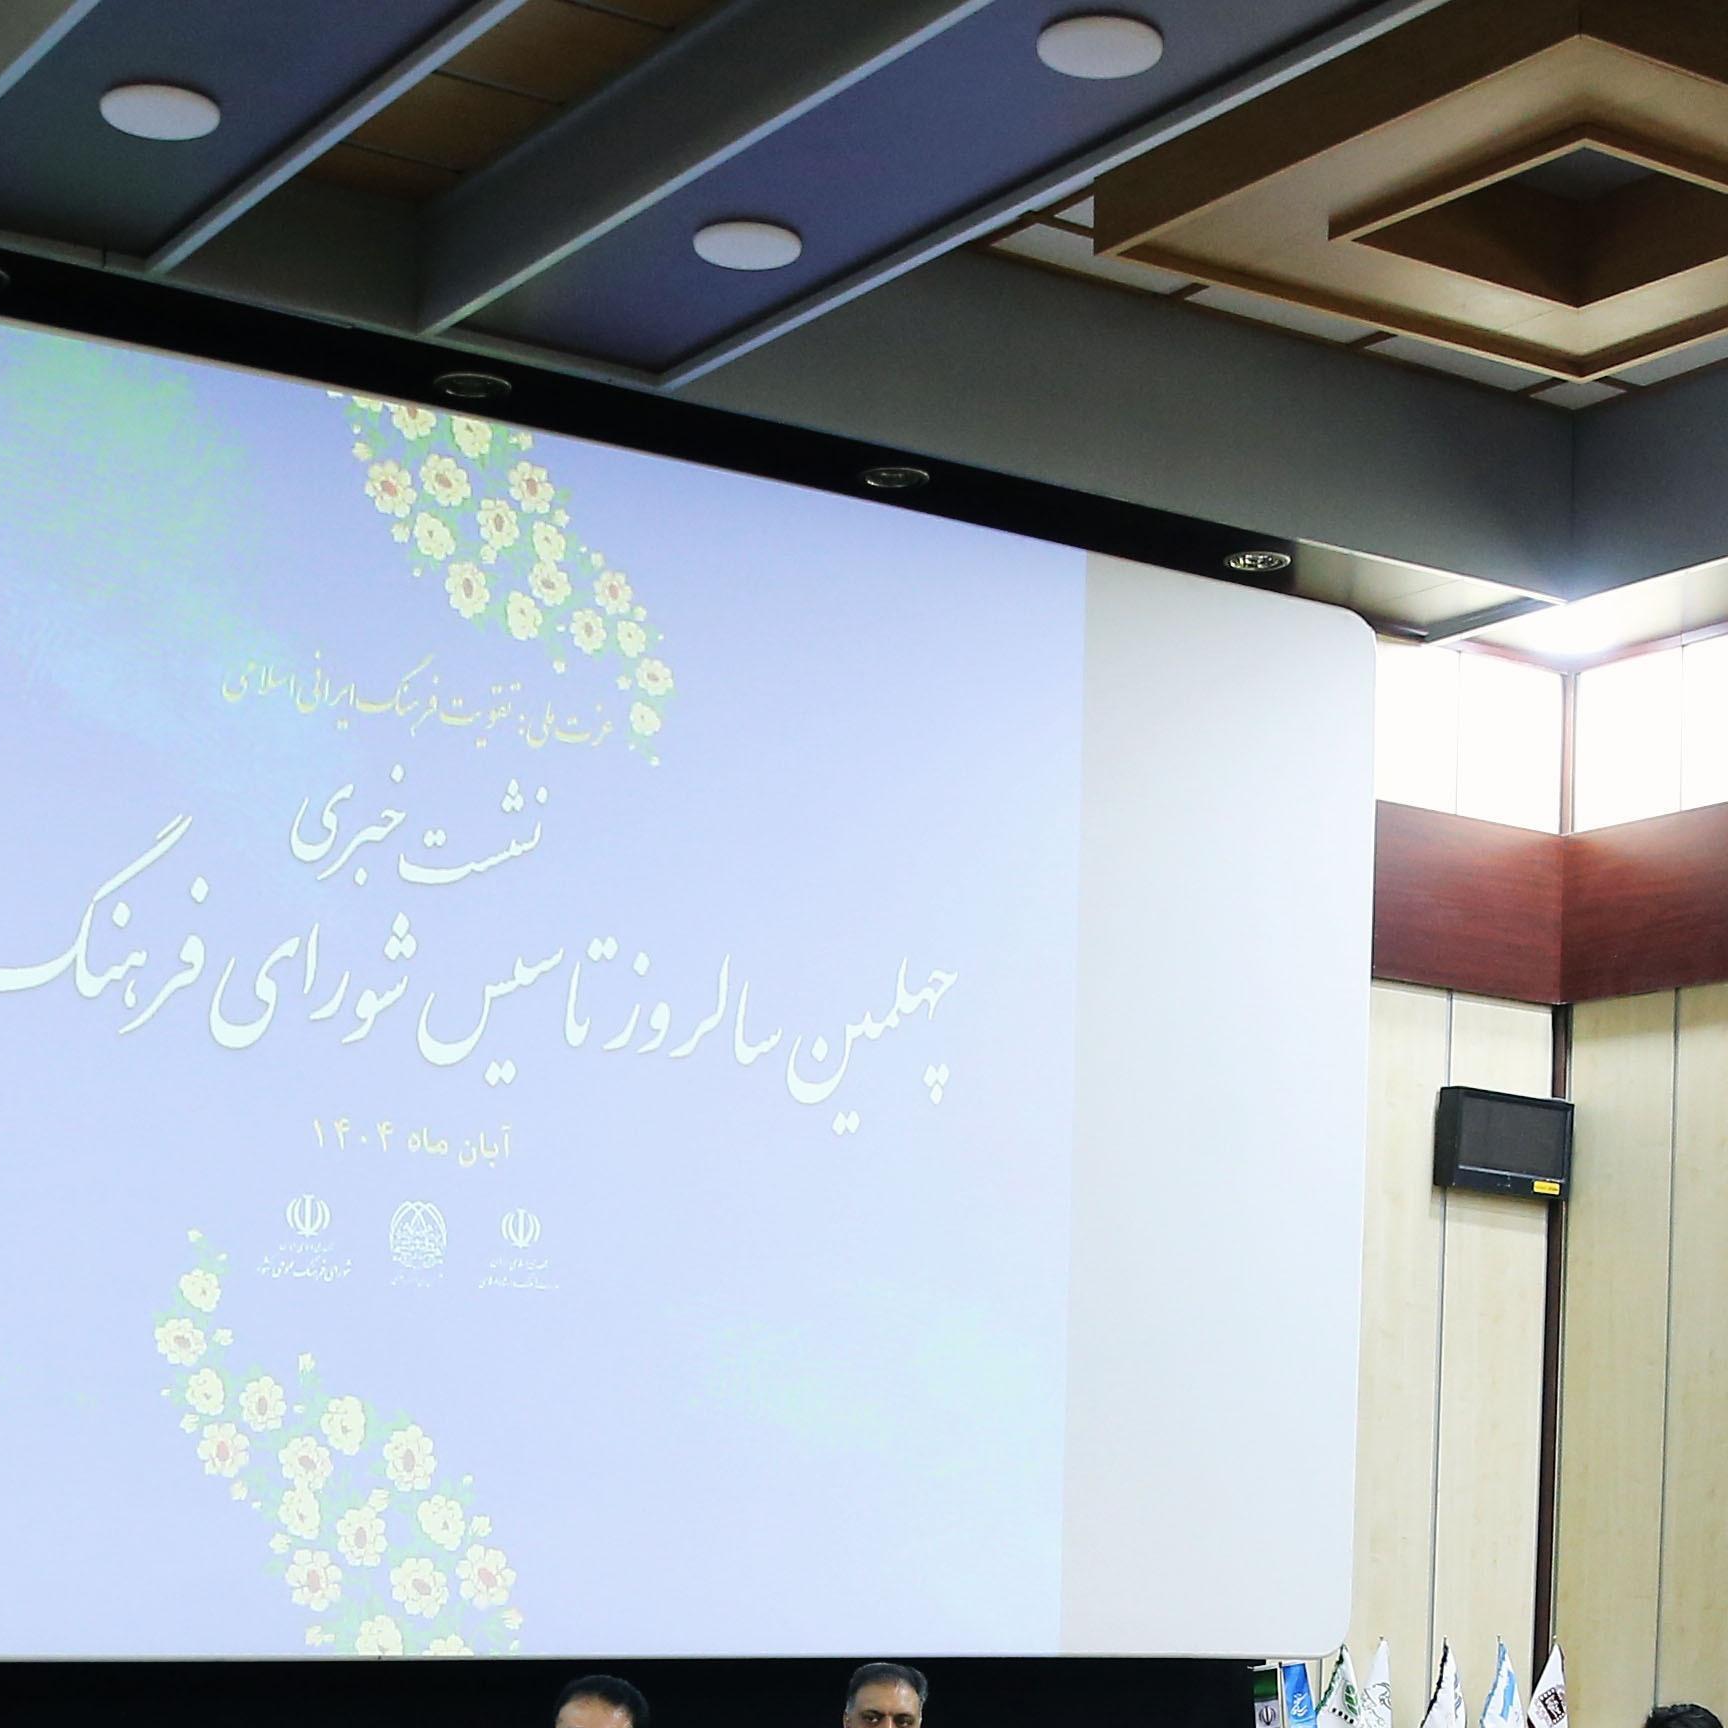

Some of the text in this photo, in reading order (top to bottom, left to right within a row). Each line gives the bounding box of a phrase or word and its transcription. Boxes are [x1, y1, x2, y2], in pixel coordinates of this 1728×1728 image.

[290, 763, 549, 886] نشست خبری
[209, 912, 417, 1050] شورای
[786, 956, 959, 1136] چهلمین
[313, 1117, 511, 1168] آبان ماه ۱۴۰۴
